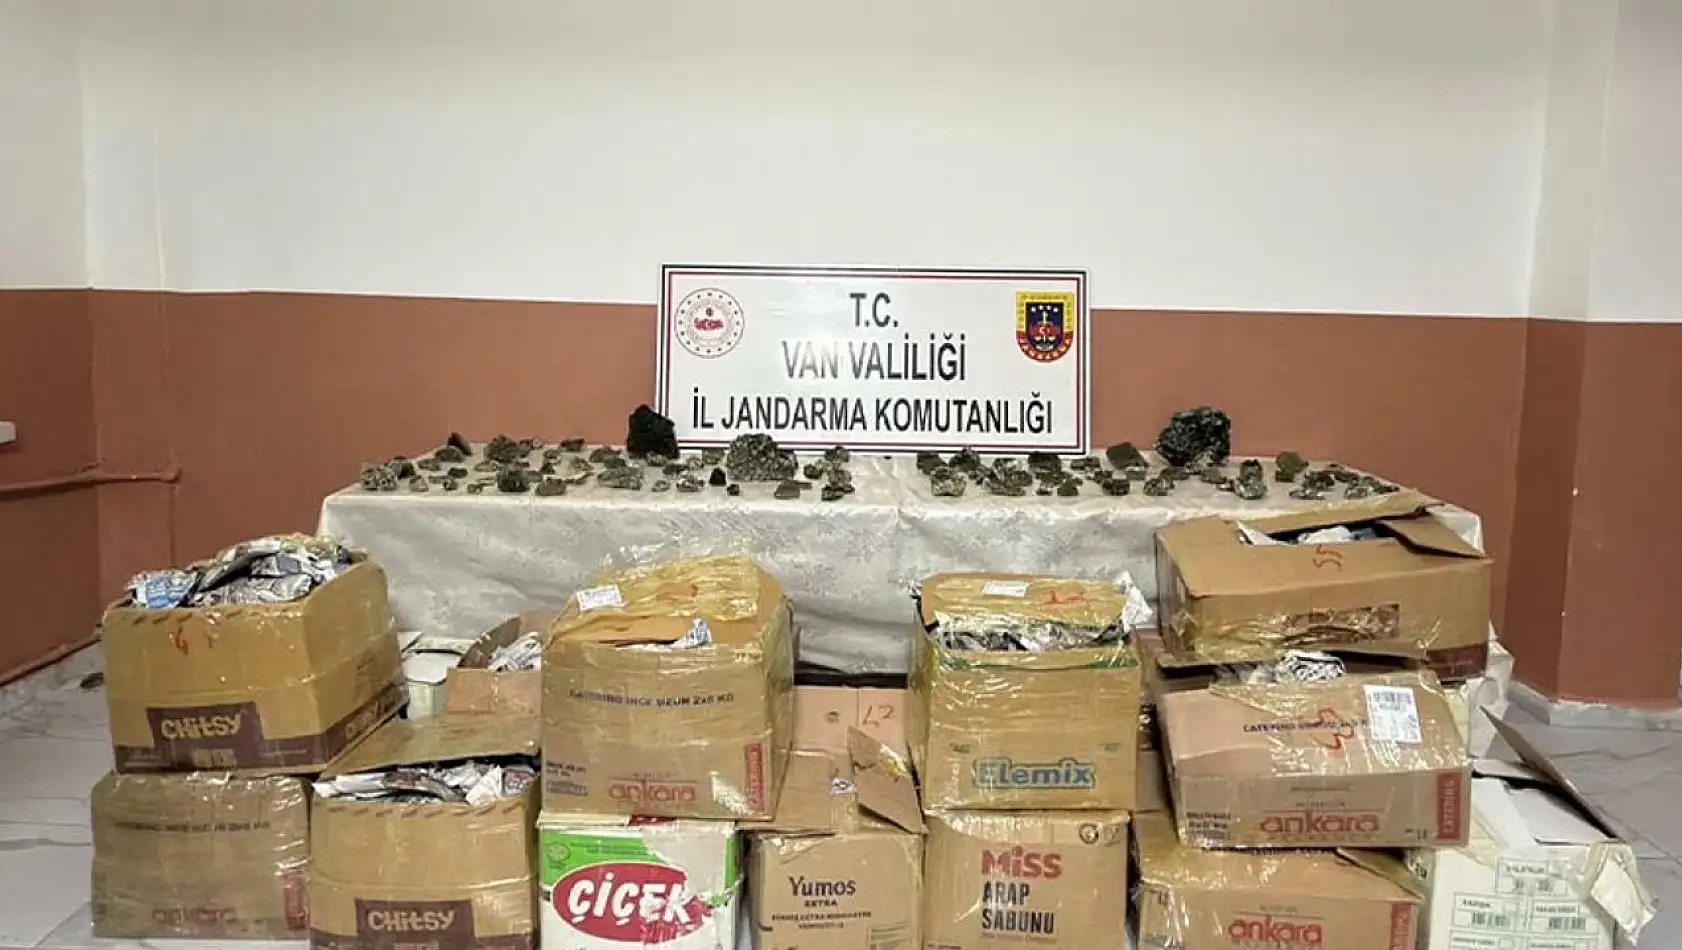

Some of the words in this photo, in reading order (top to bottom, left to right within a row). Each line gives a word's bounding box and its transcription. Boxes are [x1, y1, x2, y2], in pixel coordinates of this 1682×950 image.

[850, 292, 899, 328] T.C.
[781, 340, 839, 379] VAN
[848, 332, 966, 381] VALİLİĞİ
[693, 386, 714, 429] İL
[721, 396, 867, 431] JANDARMA
[875, 391, 1052, 434] KOMUTANLIĞI
[1260, 810, 1380, 834] ankara
[568, 871, 691, 926] ÇİÇEK
[983, 881, 1030, 905] ARAP
[982, 908, 1054, 934] SABUNU
[1228, 915, 1323, 943] ankara
